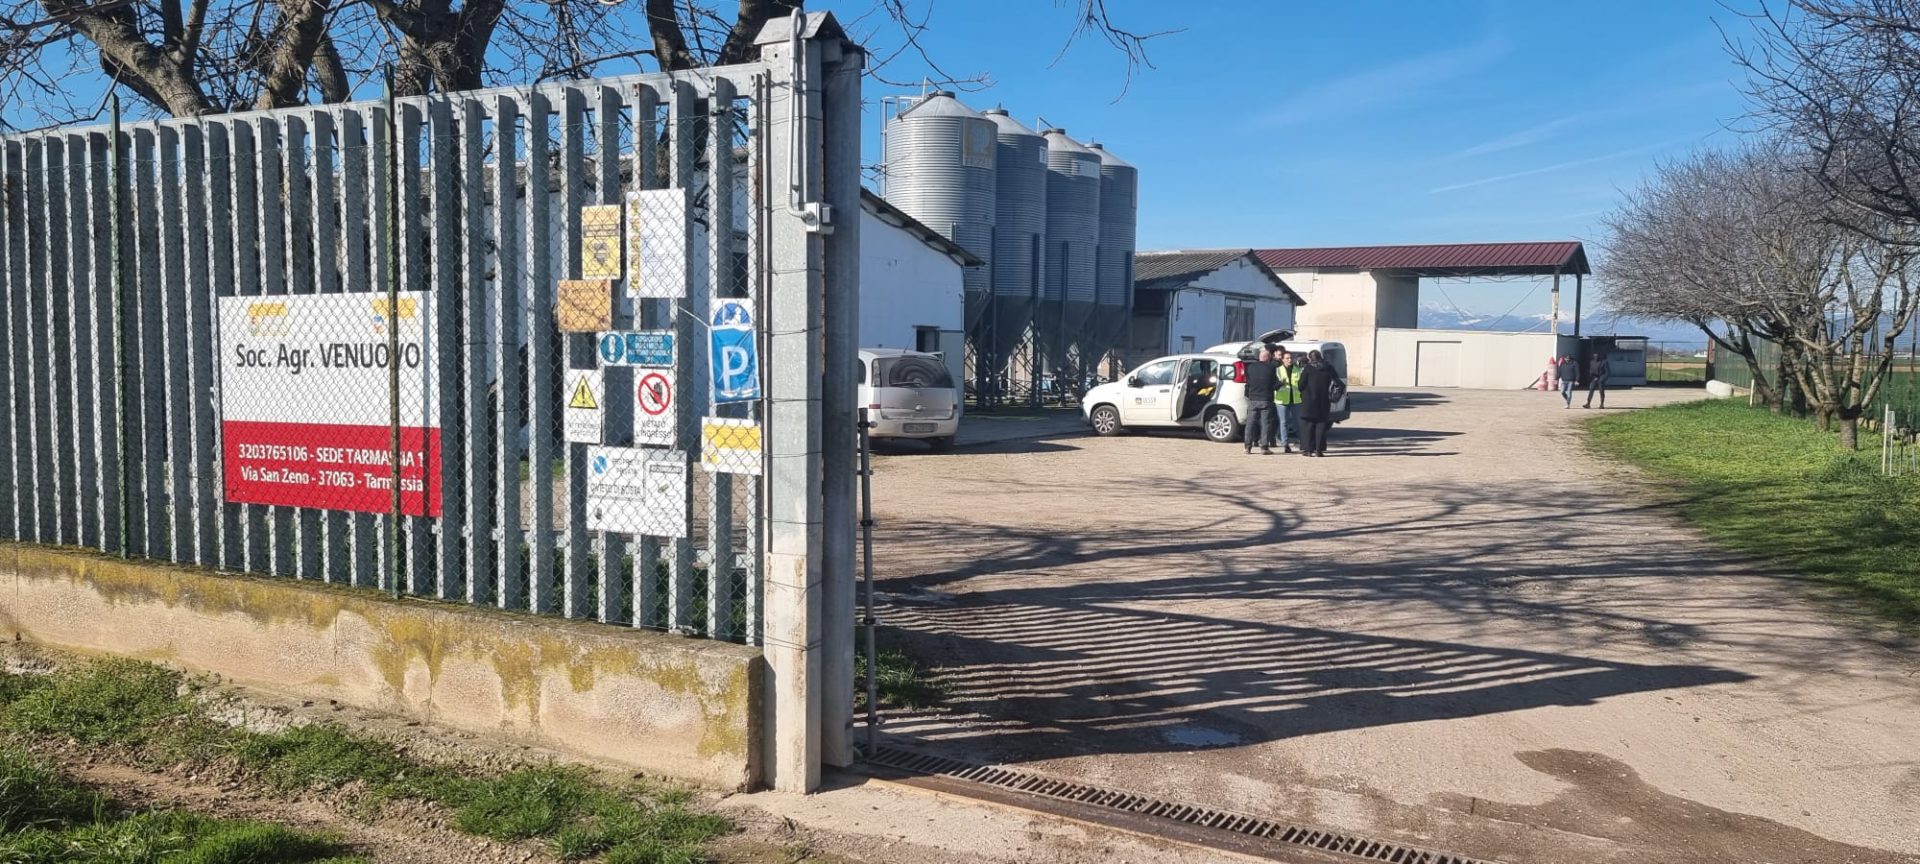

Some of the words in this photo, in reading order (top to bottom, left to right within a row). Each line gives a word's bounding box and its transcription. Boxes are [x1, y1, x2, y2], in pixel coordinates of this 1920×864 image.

[236, 343, 271, 368] Soc.
[277, 343, 314, 375] Agr.
[320, 342, 420, 369] VENUOO
[722, 345, 749, 396] P
[239, 444, 308, 462] 3203765106
[316, 447, 344, 463] SEDE
[241, 466, 259, 481] Via
[260, 467, 279, 483] San
[282, 468, 310, 485] Zeno
[318, 470, 355, 488] 37063
[364, 473, 424, 492] Tarmssia
